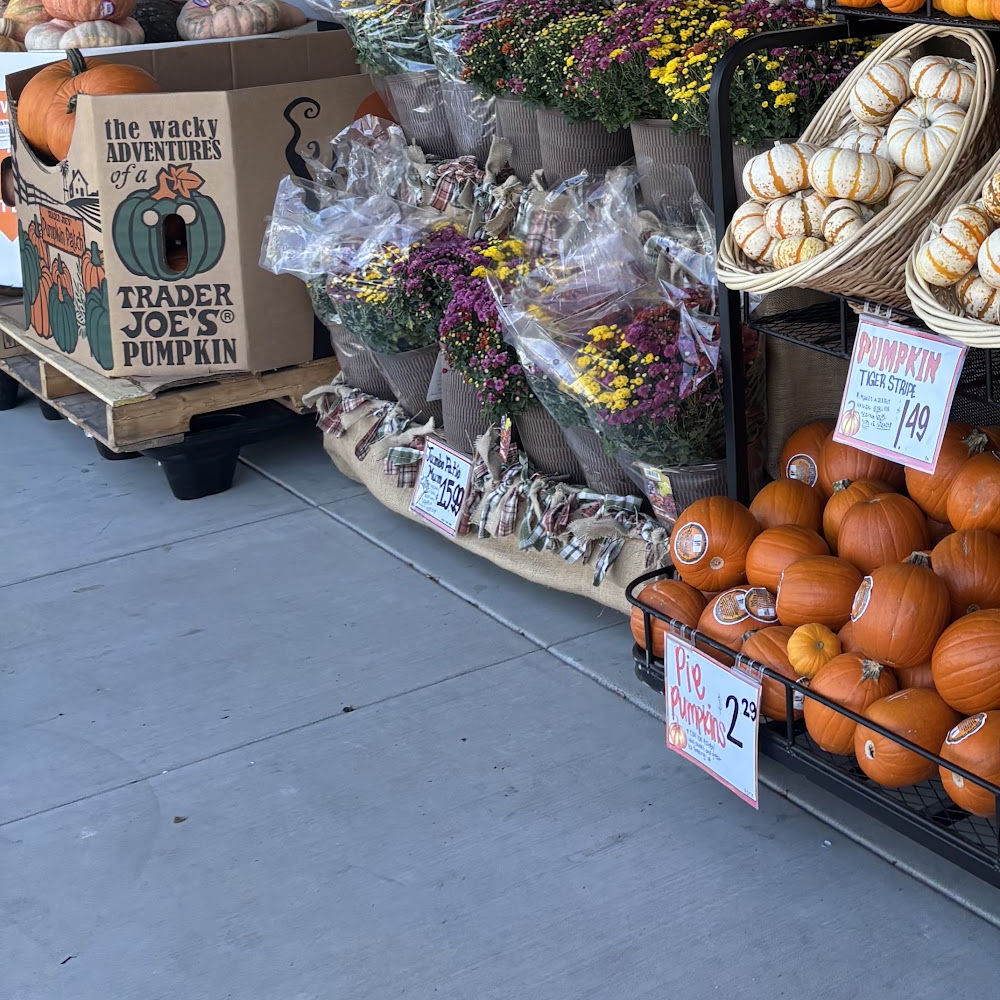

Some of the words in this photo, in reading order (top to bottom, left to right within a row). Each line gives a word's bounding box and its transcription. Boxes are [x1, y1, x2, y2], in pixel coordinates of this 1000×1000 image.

[104, 118, 140, 140] the
[148, 116, 219, 140] wacky
[106, 139, 222, 162] ADVENTURES
[110, 165, 133, 189] of
[134, 170, 147, 184] a
[116, 284, 234, 308] TRADER
[122, 339, 238, 367] PUMPKIN
[857, 331, 942, 384] PUMPKIN
[860, 369, 886, 390] TIGER
[887, 376, 917, 398] STRIPE
[426, 446, 444, 470] Jumbo
[444, 455, 461, 479] Patio
[427, 465, 442, 484] Mum
[675, 645, 705, 700] Pie
